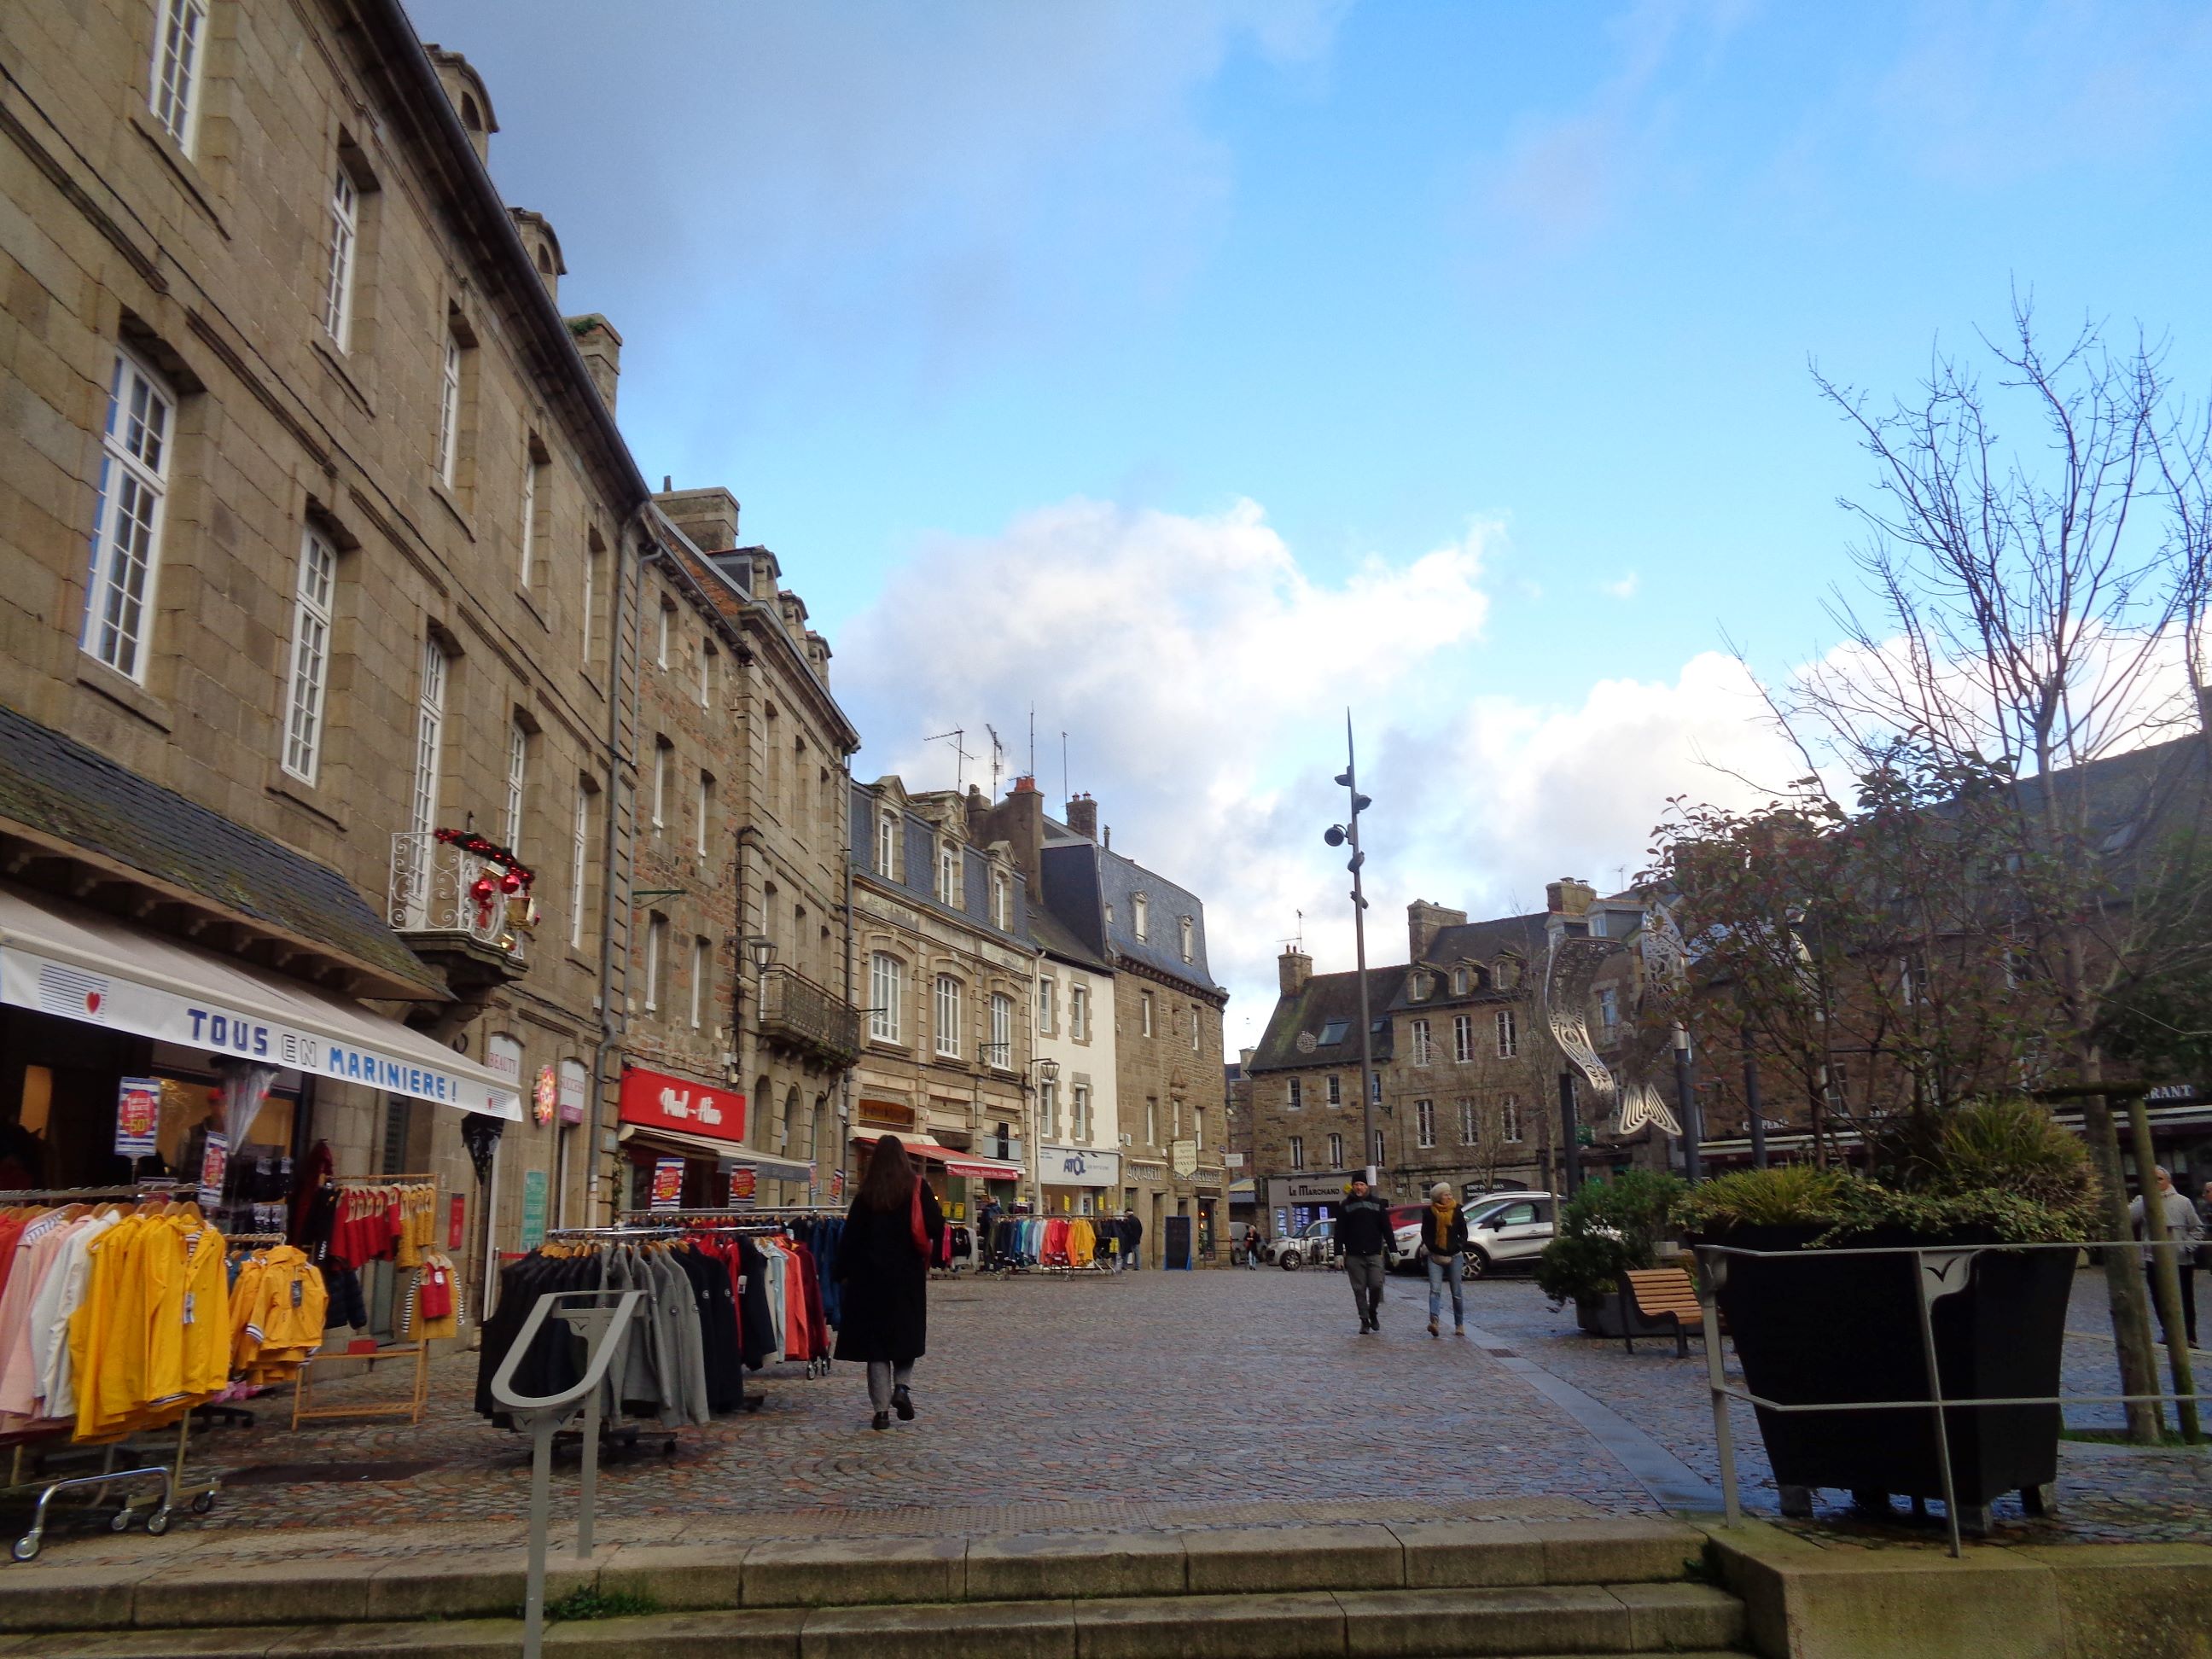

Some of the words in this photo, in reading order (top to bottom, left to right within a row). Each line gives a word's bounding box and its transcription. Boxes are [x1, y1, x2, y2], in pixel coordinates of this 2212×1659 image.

[187, 1008, 268, 1056] TOUS
[281, 1033, 317, 1068] EN
[329, 1045, 445, 1099] MARINIERE
[451, 1080, 457, 1103] !
[488, 1052, 517, 1074] BEAUTY
